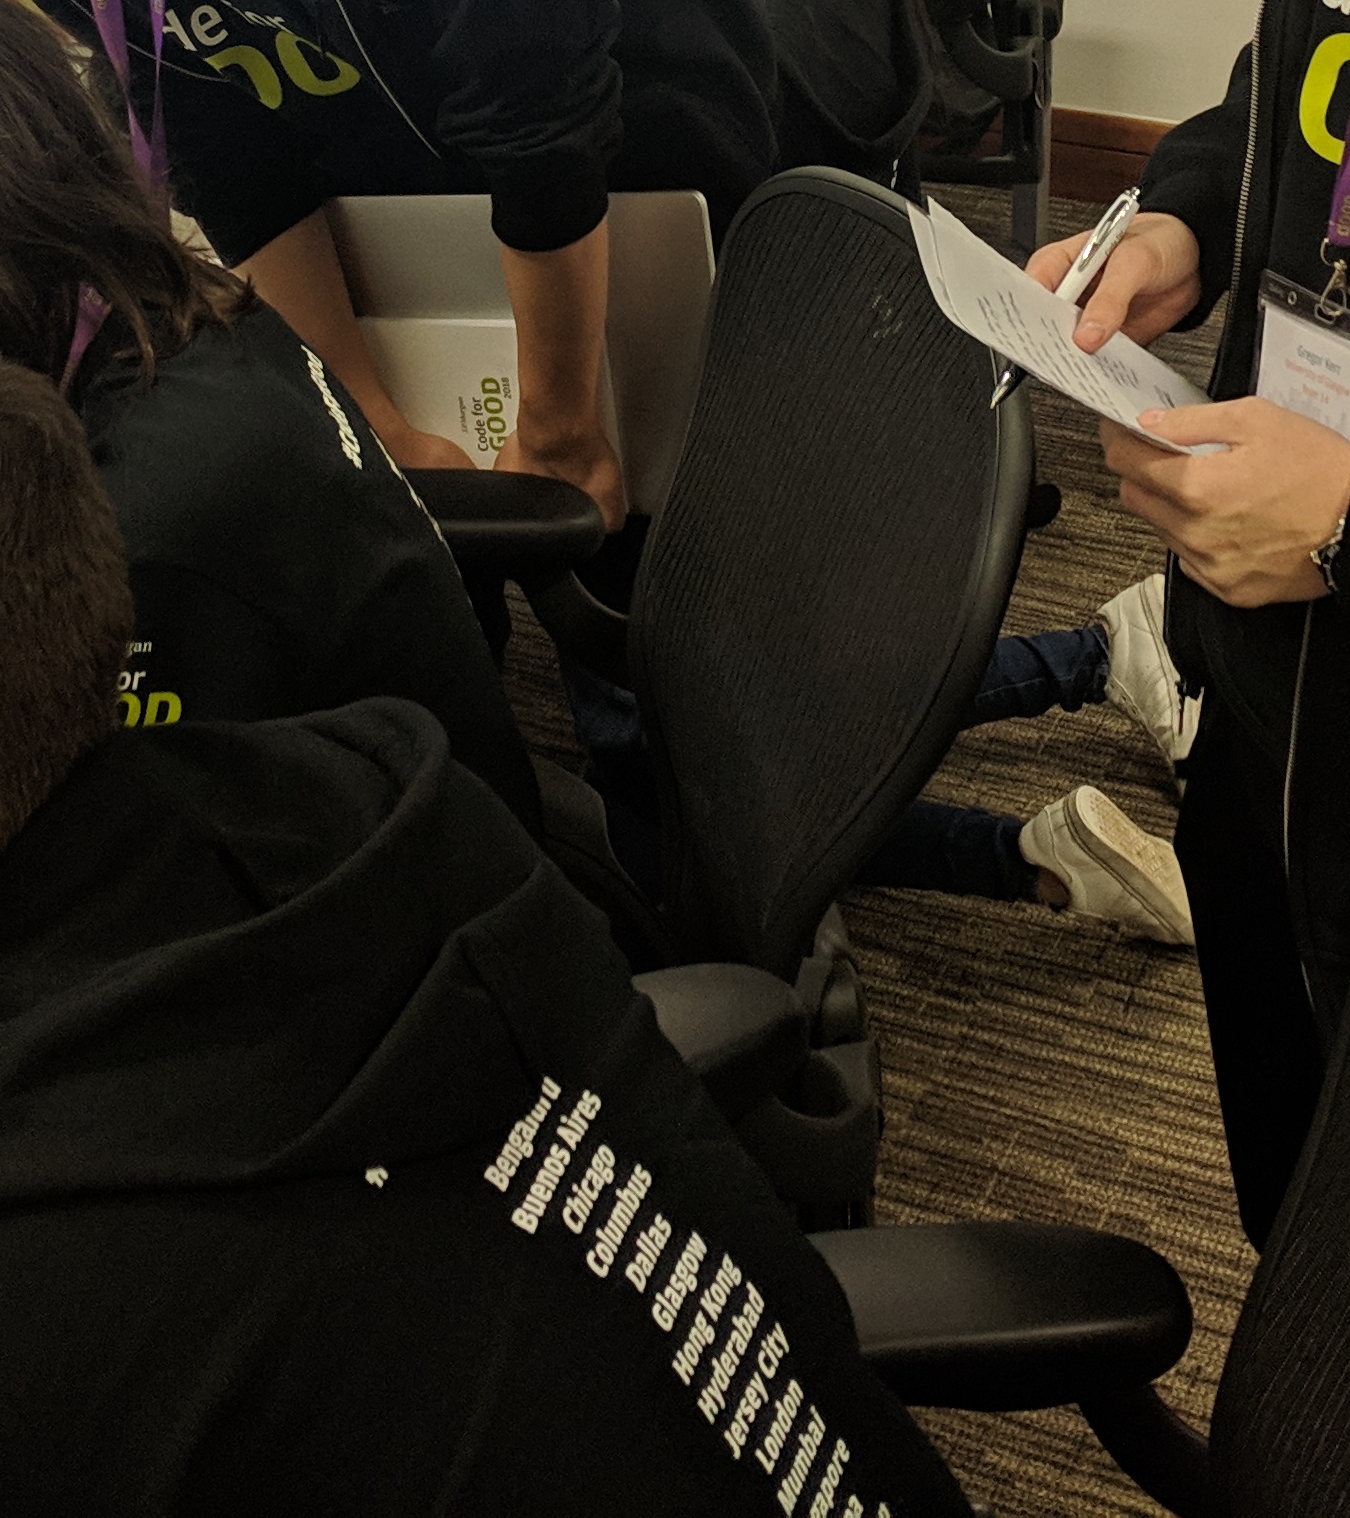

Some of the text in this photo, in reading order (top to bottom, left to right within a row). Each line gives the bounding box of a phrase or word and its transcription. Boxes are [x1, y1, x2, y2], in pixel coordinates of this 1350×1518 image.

[471, 396, 489, 452] Code for
[480, 376, 508, 452] GOOD
[501, 377, 512, 400] 2018
[116, 670, 147, 691] or
[511, 1089, 602, 1235] Buenos Aires
[562, 1144, 616, 1235] Chicago
[586, 1163, 652, 1278] Columbus
[625, 1212, 672, 1294] Dallas
[652, 1230, 707, 1332] Glasgow
[672, 1252, 742, 1386] Hong Kong
[697, 1281, 765, 1424] Hyderabad
[723, 1322, 790, 1460] Jersey City
[755, 1379, 804, 1475] London
[777, 1404, 826, 1518] Mumbai
